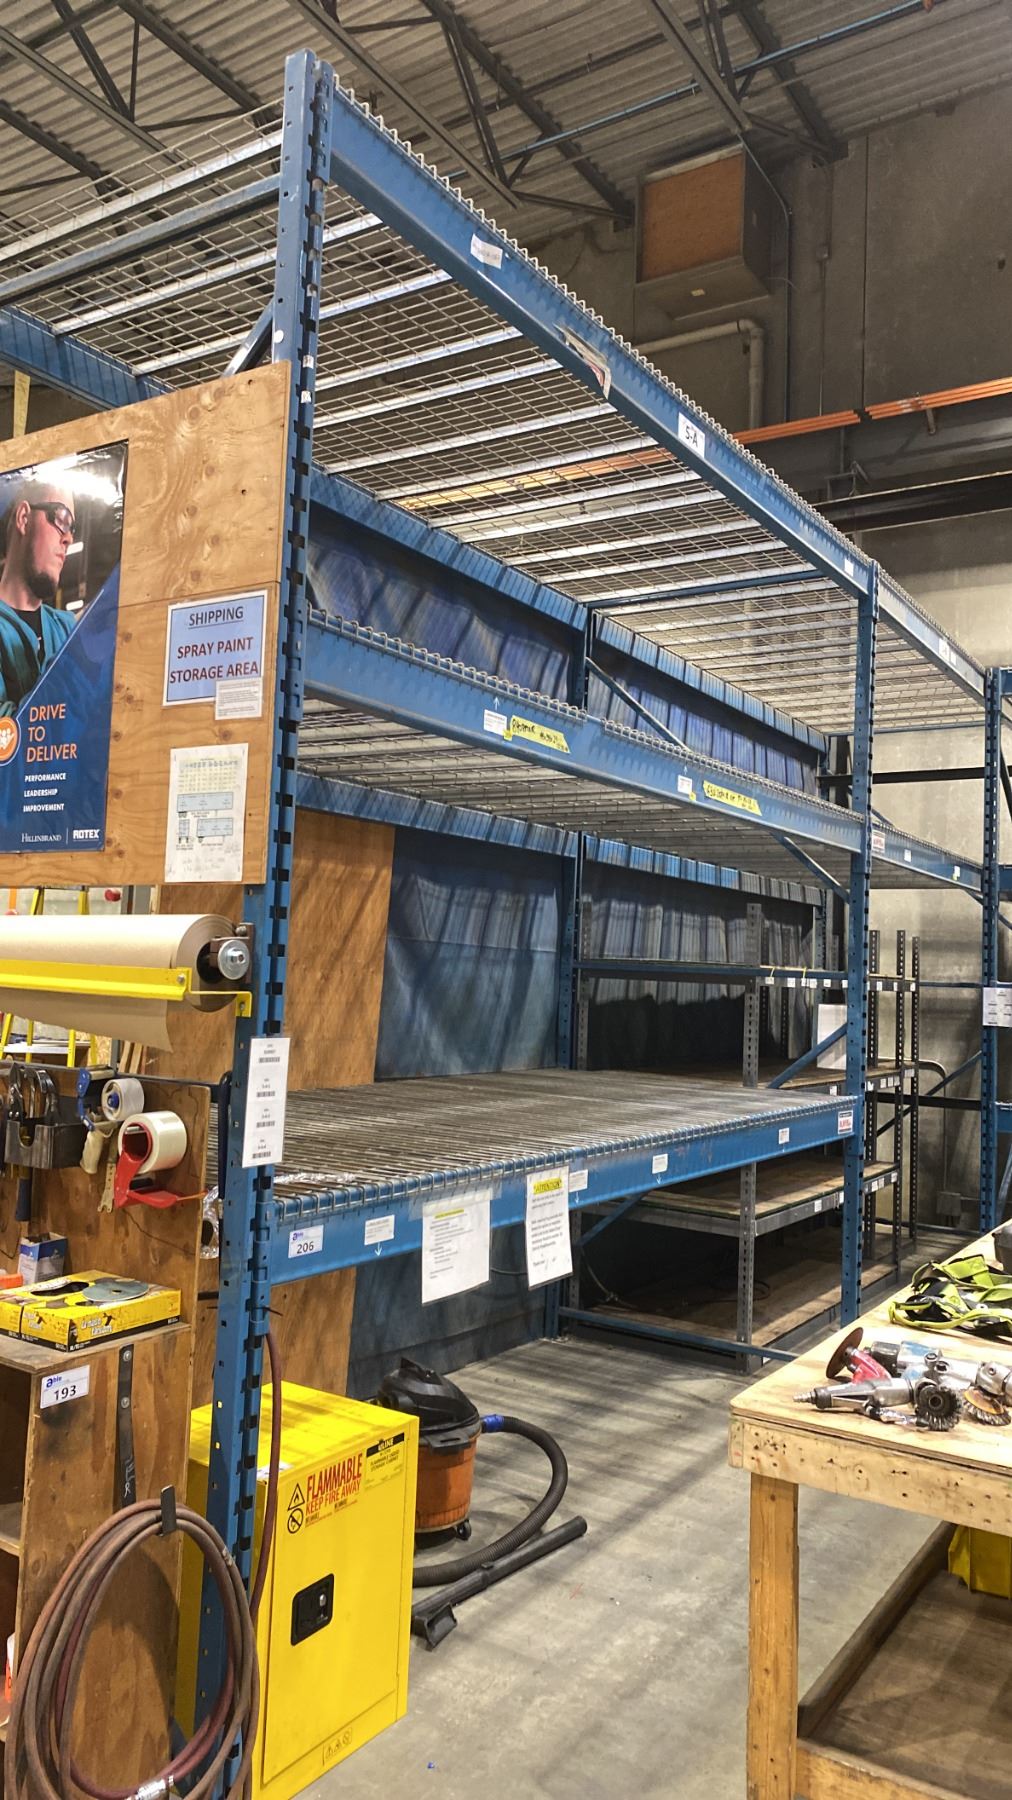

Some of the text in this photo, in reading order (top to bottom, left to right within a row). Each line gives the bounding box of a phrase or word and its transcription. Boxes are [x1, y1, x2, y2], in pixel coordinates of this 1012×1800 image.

[189, 606, 244, 626] SHIPPING
[177, 637, 254, 659] SPRAY PAINT
[169, 661, 259, 684] STORAGE AREA
[29, 703, 67, 723] DRIVE
[28, 726, 46, 742] TO
[26, 743, 78, 763] DELIVER
[24, 772, 67, 783] PERFORMANCE
[23, 788, 58, 798] LEADERSHIP
[23, 803, 65, 813] IMPROVEMENT
[73, 829, 100, 840] ROTEX
[296, 1241, 314, 1254] 206
[54, 1385, 76, 1401] 193
[306, 1453, 362, 1502] FLAMMABLE
[305, 1496, 324, 1516] KEEP
[324, 1489, 341, 1507] FIRE
[341, 1479, 361, 1498] AWAY
